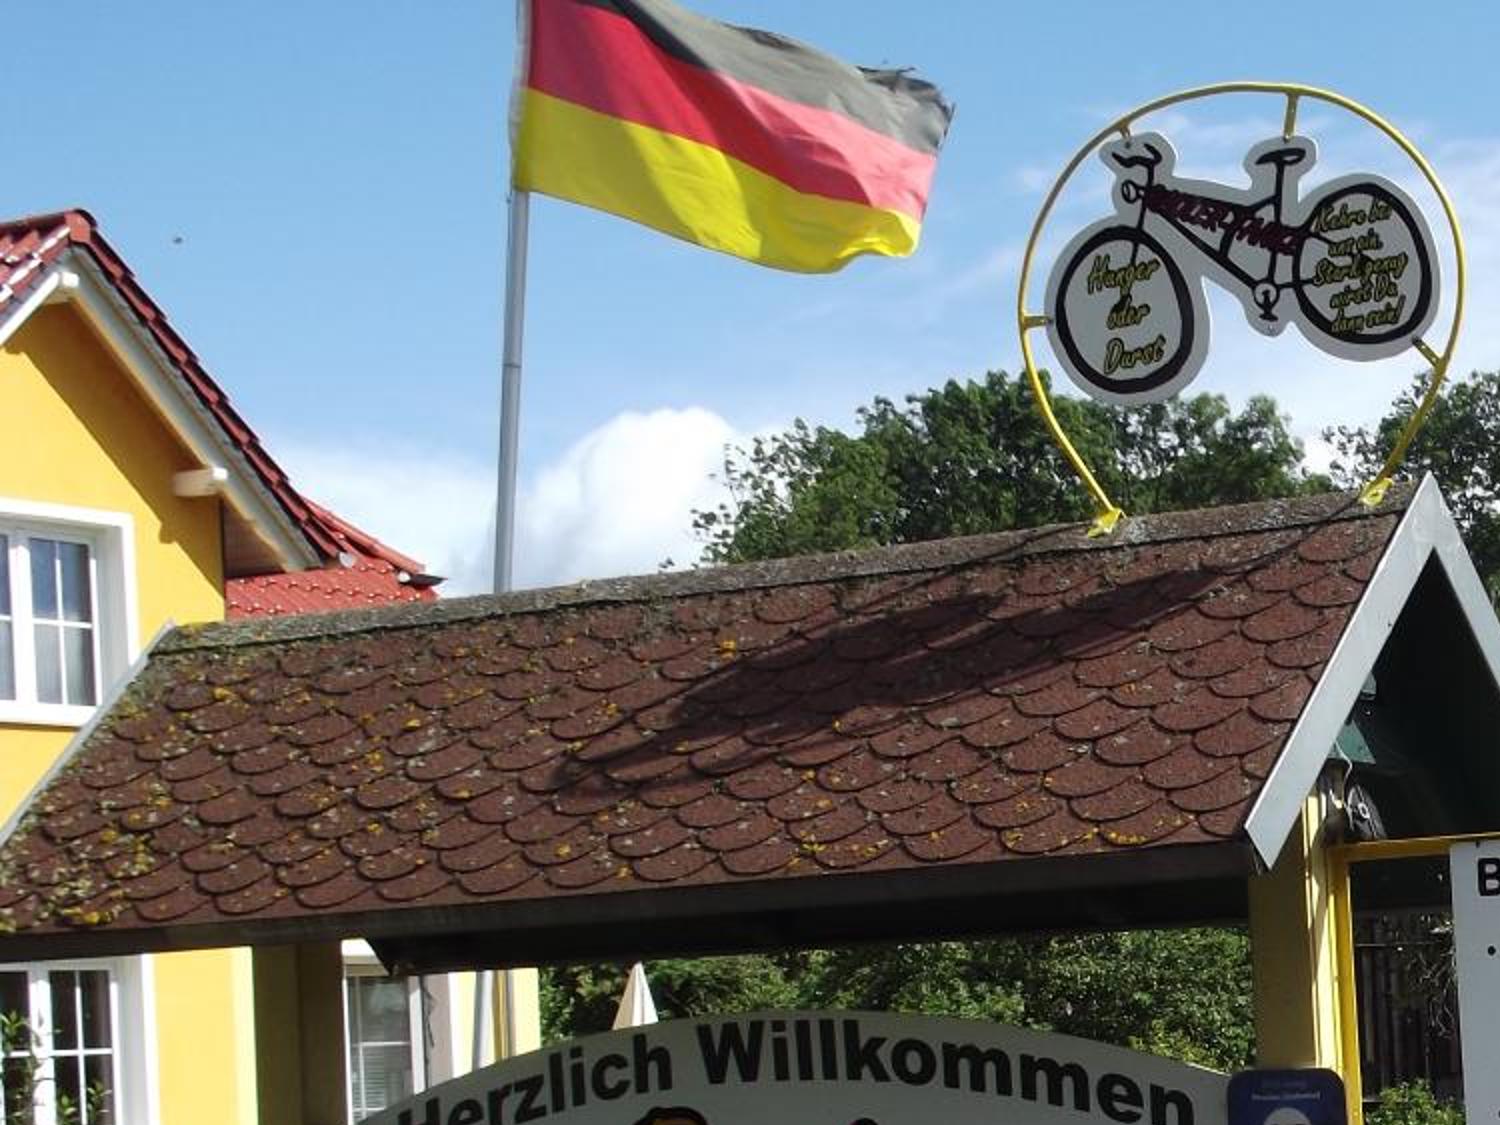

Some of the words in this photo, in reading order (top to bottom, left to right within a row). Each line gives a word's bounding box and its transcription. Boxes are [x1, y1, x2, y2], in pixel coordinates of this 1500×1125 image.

[1087, 255, 1161, 297] Hunger
[1106, 302, 1151, 331] oder
[1103, 334, 1168, 375] Durst
